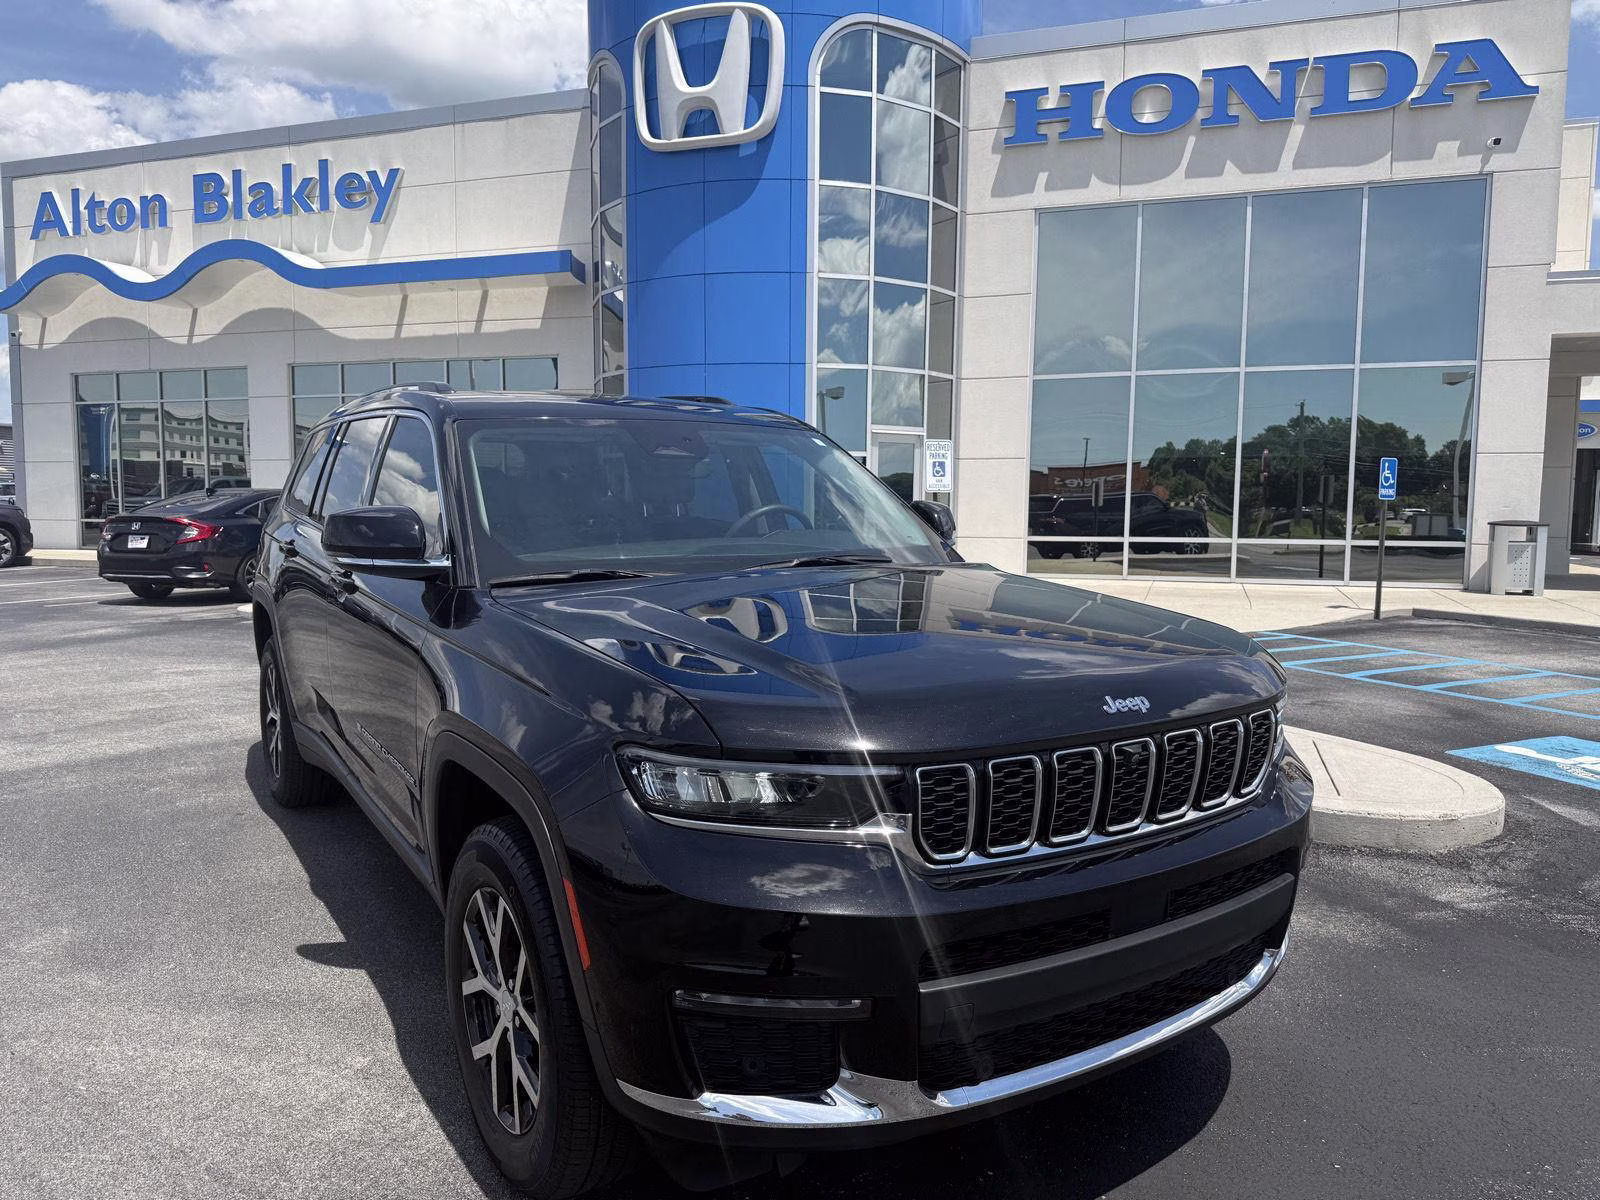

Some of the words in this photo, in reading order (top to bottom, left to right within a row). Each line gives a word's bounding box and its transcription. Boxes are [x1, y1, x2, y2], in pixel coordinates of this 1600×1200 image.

[1003, 38, 1540, 147] HONDA
[29, 187, 170, 241] Alton
[193, 158, 402, 225] Blakley
[927, 443, 951, 451] RESERVED
[929, 451, 949, 459] PARKING
[1102, 695, 1150, 714] Jeep
